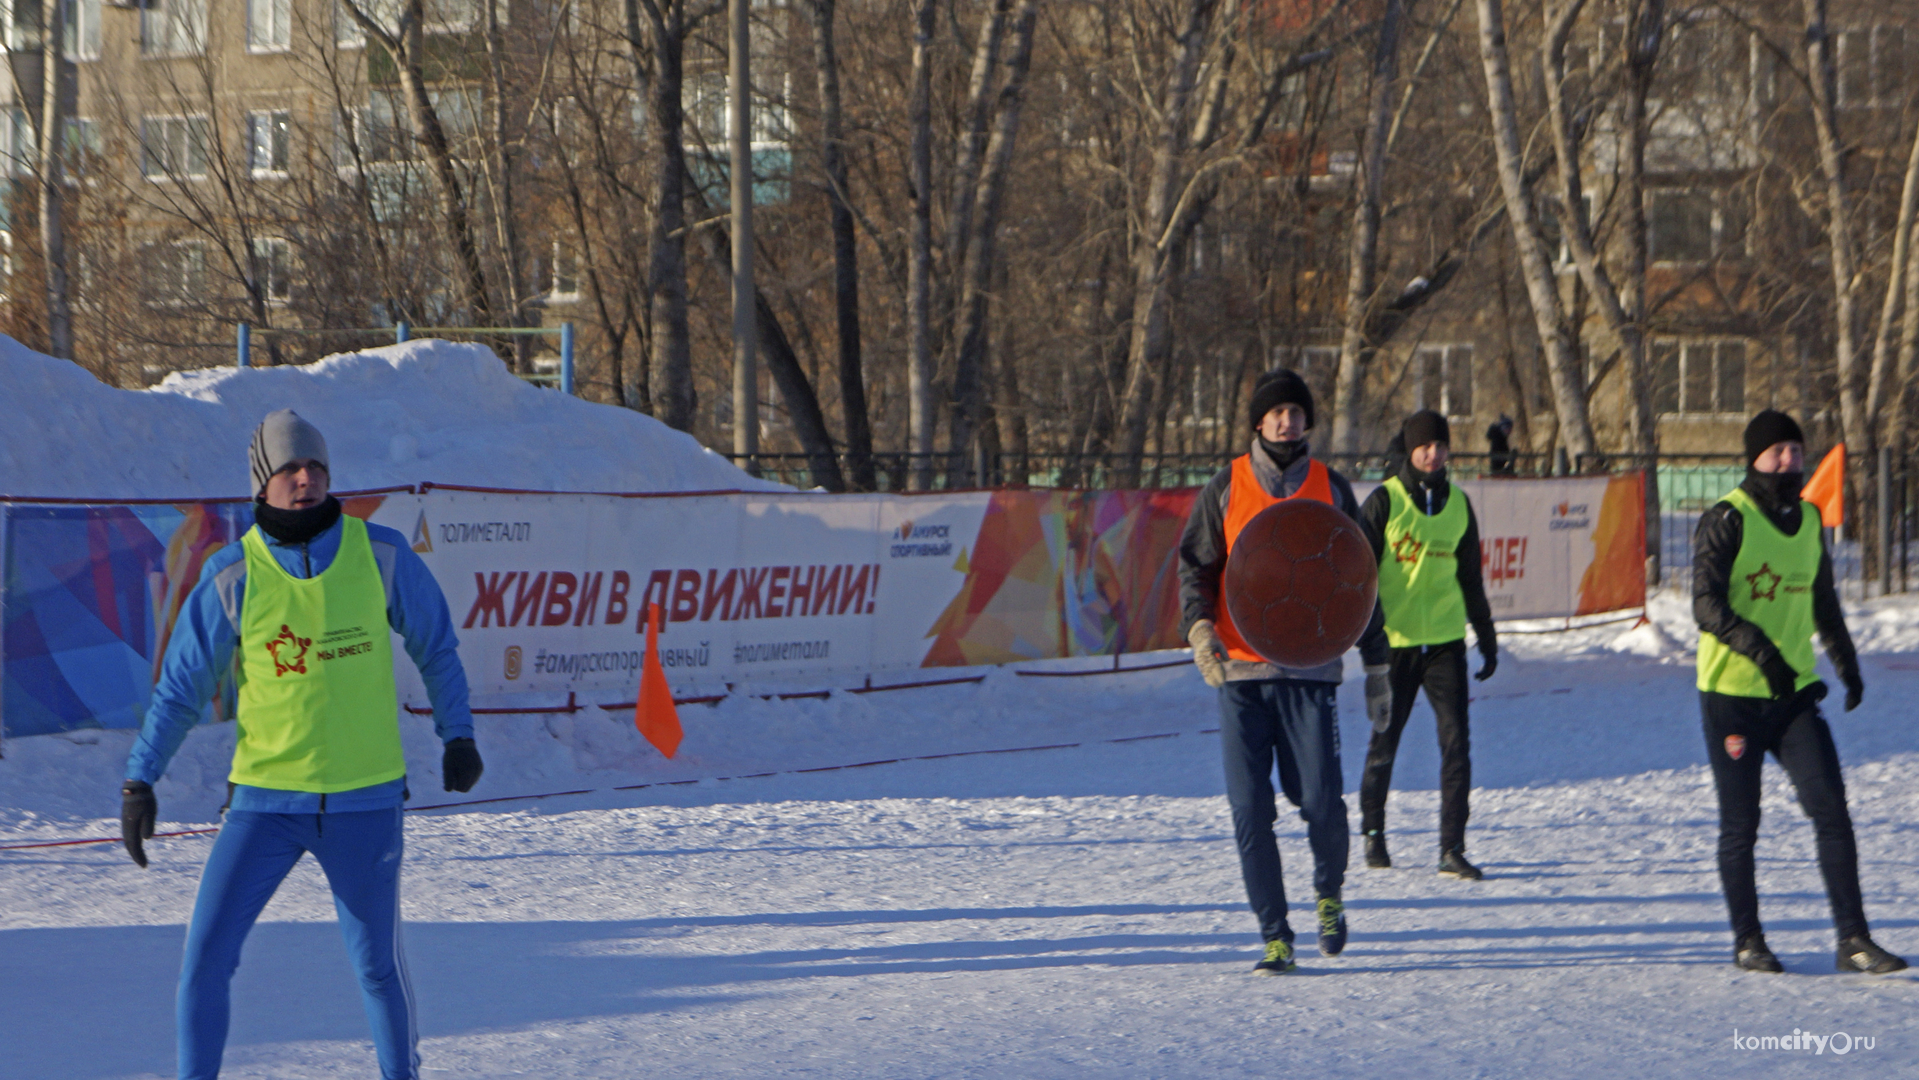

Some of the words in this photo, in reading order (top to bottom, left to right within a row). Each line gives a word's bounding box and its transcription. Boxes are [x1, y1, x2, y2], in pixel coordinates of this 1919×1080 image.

[439, 522, 531, 543] ПОЛИМЕТАЛЛ
[461, 570, 603, 629] ЖИВИ
[604, 570, 631, 625] В
[635, 564, 881, 634] ДВИЖЕНИИ!
[316, 649, 336, 661] МЫ
[732, 640, 830, 664] #полиметалл
